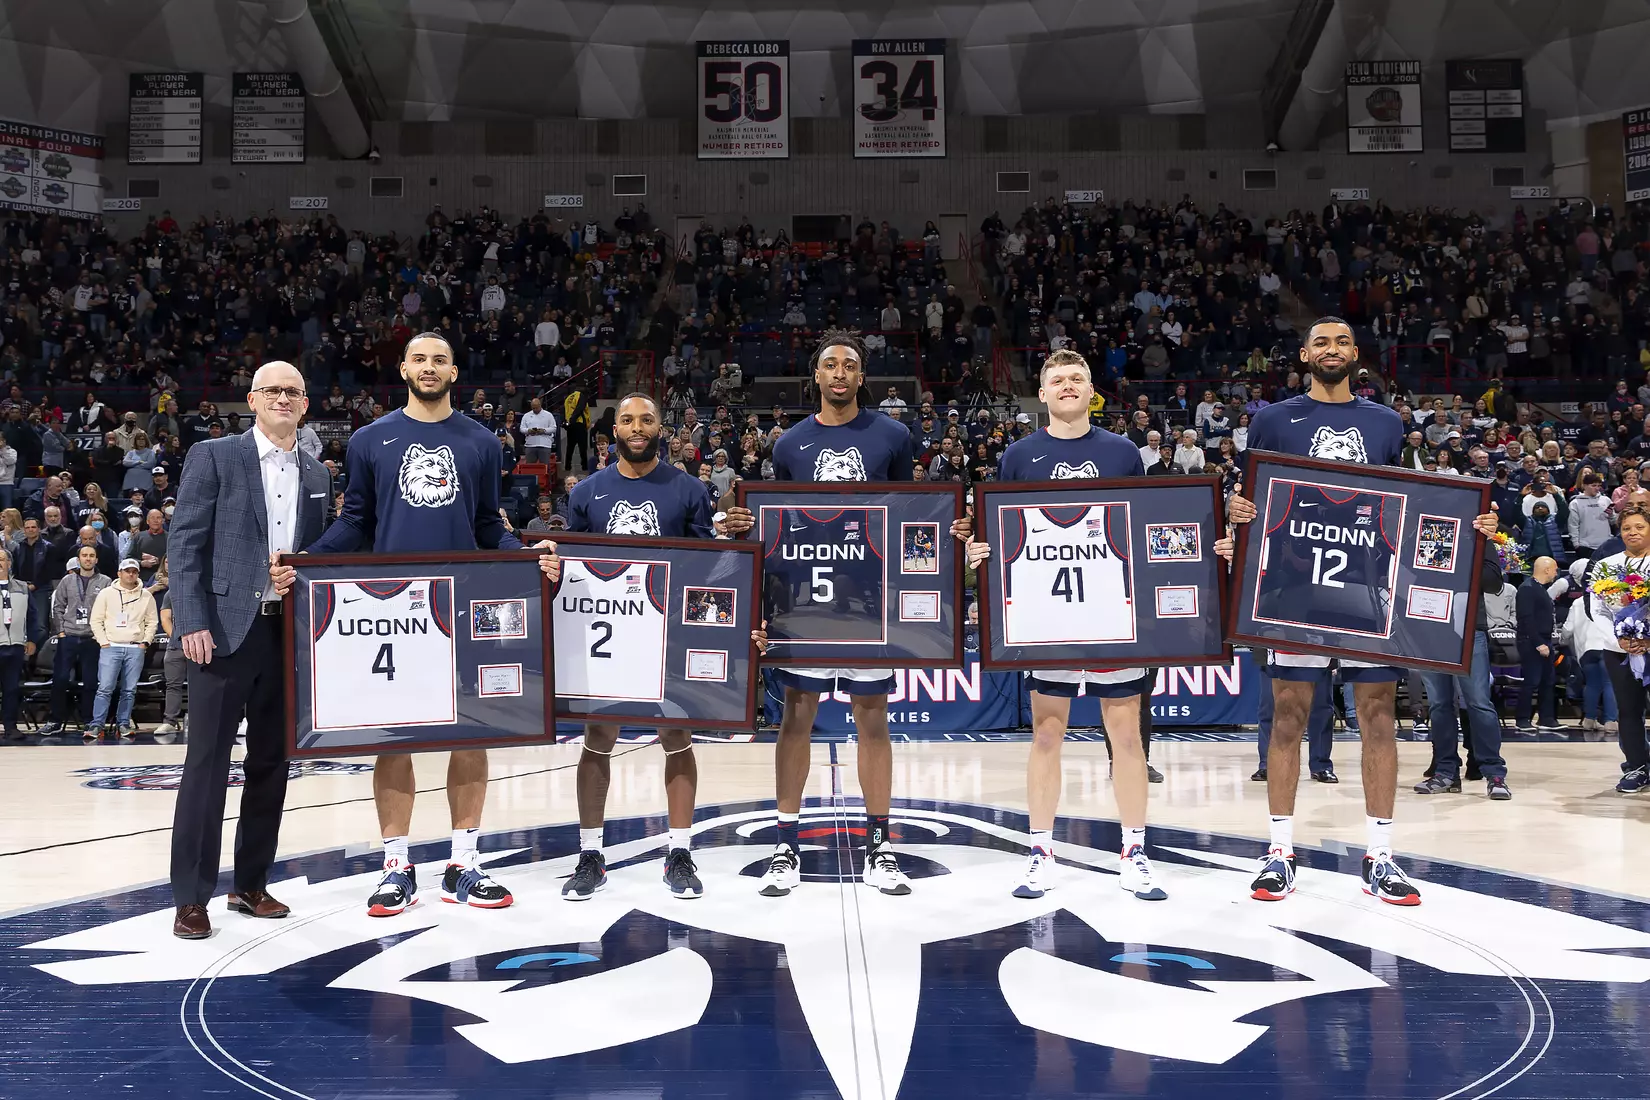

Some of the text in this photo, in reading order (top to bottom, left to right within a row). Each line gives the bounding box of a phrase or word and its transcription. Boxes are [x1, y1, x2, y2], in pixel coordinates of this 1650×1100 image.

[706, 43, 779, 54] REBECCA LOBO
[871, 42, 925, 53] RAY ALLEN
[143, 74, 189, 82] NATIONAL
[275, 88, 300, 96] YEAR
[704, 61, 782, 123] 50
[860, 60, 938, 121] 34
[0, 135, 72, 153] INAL FOUR
[560, 197, 583, 205] 208
[1352, 190, 1368, 198] 211
[1530, 188, 1549, 197] 212
[118, 200, 140, 208] 206
[306, 199, 327, 207] 207
[1289, 519, 1376, 548] UCONN
[782, 544, 865, 561] UCONN
[1026, 543, 1107, 561] UCONN
[1311, 546, 1348, 589] 12
[812, 566, 834, 603] 5
[1051, 566, 1084, 603] 41
[562, 596, 644, 616] UCONN
[337, 617, 428, 636] UCONN
[590, 620, 613, 659] 2
[371, 643, 396, 681] 4
[845, 711, 930, 723] HKIES
